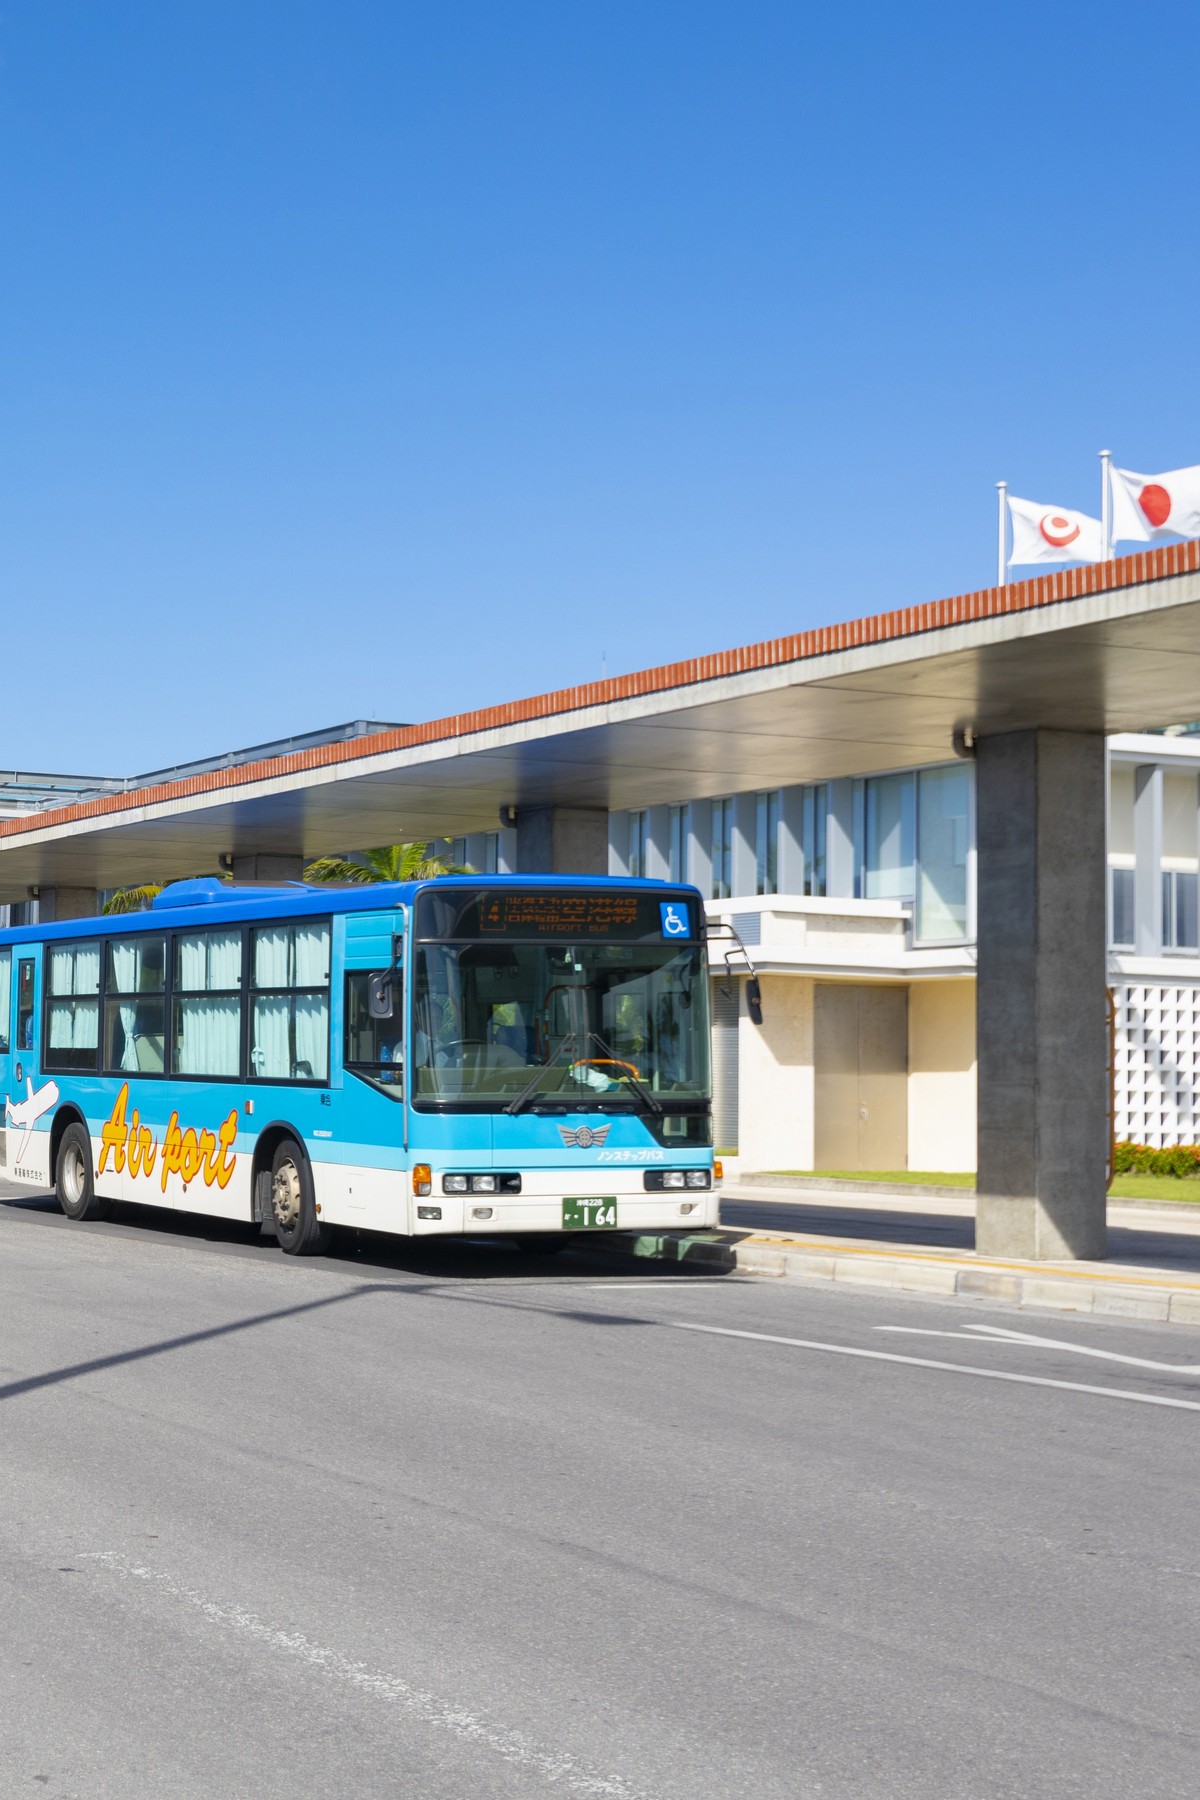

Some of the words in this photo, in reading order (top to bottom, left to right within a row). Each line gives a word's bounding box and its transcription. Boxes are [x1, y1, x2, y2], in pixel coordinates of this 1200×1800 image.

[596, 1150, 665, 1161] ノンステップバス
